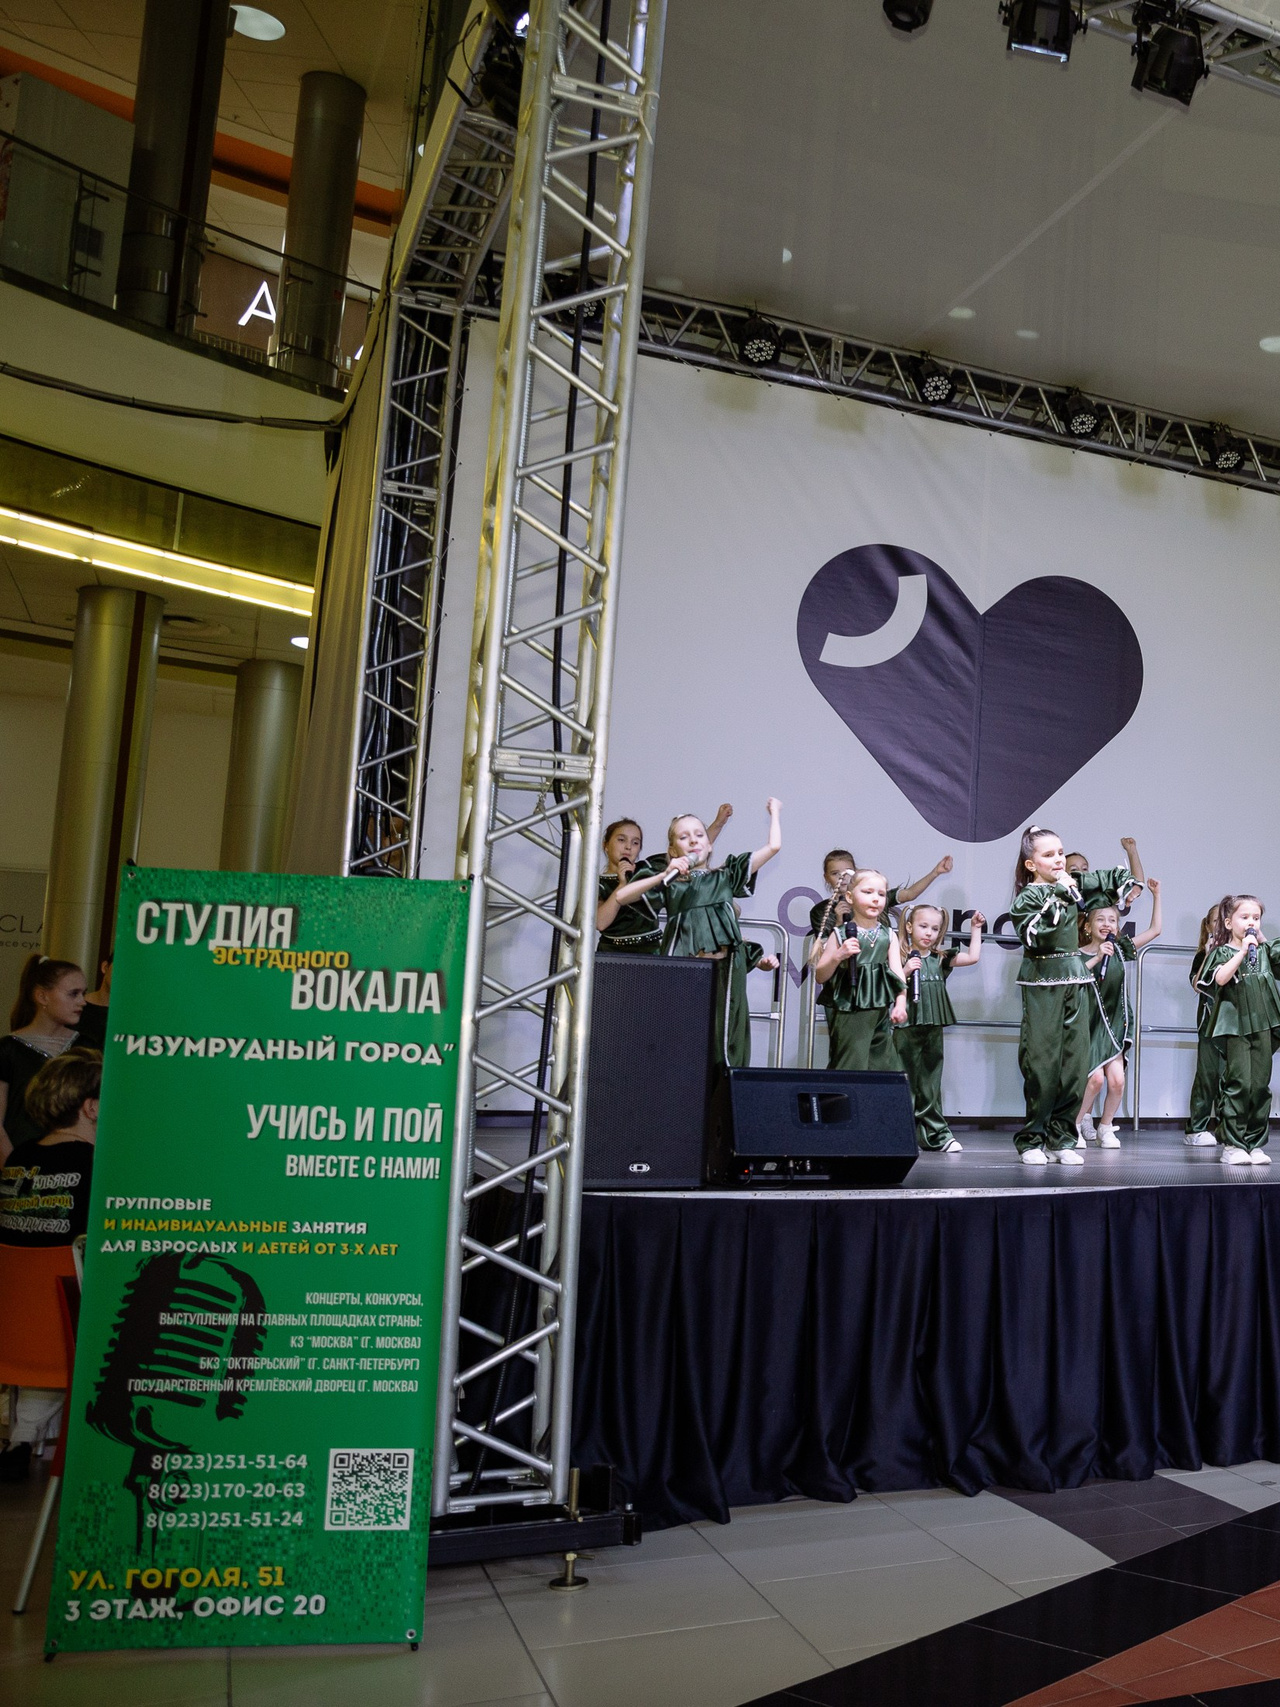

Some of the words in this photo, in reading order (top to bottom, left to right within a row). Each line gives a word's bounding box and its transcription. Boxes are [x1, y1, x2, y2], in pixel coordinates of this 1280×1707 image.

[136, 901, 293, 950] СТУДИЯ
[213, 947, 349, 973] ЭСТРАДНОГО
[291, 969, 441, 1014] ВОКАЛА
[114, 1034, 335, 1061] “ИЗУМРУДНЫЙ
[345, 1041, 454, 1065] ГОРОД”
[247, 1104, 346, 1140] УЧИСЬ
[354, 1107, 375, 1141] И
[383, 1103, 443, 1143] ПОЙ
[286, 1155, 360, 1178] ВМЕСТЕ
[364, 1156, 376, 1178] С
[380, 1157, 440, 1179] НАМИ!
[106, 1197, 212, 1211] ГРУППОВЫЕ
[104, 1218, 116, 1230] И
[121, 1219, 287, 1233] ИНДИВИДУАЛЬНЫЕ
[292, 1221, 367, 1234] ЗАНЯТИЯ
[101, 1240, 135, 1253] ДЛЯ
[141, 1240, 237, 1253] ВЗРОСЛЫХ
[242, 1242, 254, 1253] И
[257, 1240, 310, 1254] ДЕТЕЙ
[314, 1243, 336, 1254] ОТ
[340, 1243, 365, 1255] 3-Х
[368, 1244, 398, 1255] ЛЕТ
[305, 1292, 363, 1305] КОНЦЕРТЫ,
[365, 1293, 423, 1306] КОНКУРСЫ,
[159, 1312, 239, 1326] ВЫСТУПЛЕНИЯ
[241, 1313, 255, 1326] НА
[257, 1313, 308, 1326] ГЛАВНЫХ
[310, 1314, 377, 1328] ПЛОЩАДКАХ
[379, 1315, 422, 1327] СТРАНЫ:
[290, 1336, 304, 1348] КЗ
[375, 1336, 421, 1348] МОСКВА)
[199, 1357, 220, 1369] БКЗ
[322, 1358, 420, 1370] САНКТ-ПЕТЕРБУРГ)
[128, 1377, 234, 1393] ГОСУДАРСТВЕННЫЙ
[236, 1377, 312, 1392] КРЕМЛЁВСКИЙ
[314, 1380, 356, 1393] ДВОРЕЦ
[373, 1380, 419, 1392] МОСКВА)
[151, 1453, 308, 1472] 8(923)251-51-64
[148, 1482, 305, 1501] 8(923)170-20-63
[146, 1511, 303, 1531] 8(923)251-51-24
[69, 1570, 115, 1590] УЛ.
[125, 1567, 248, 1589] ГОГОЛЯ,
[258, 1566, 285, 1586] 51
[65, 1600, 80, 1621] 3
[89, 1597, 183, 1620] ЭТАЖ,
[193, 1595, 284, 1617] ОФИС
[293, 1594, 326, 1615] 20
